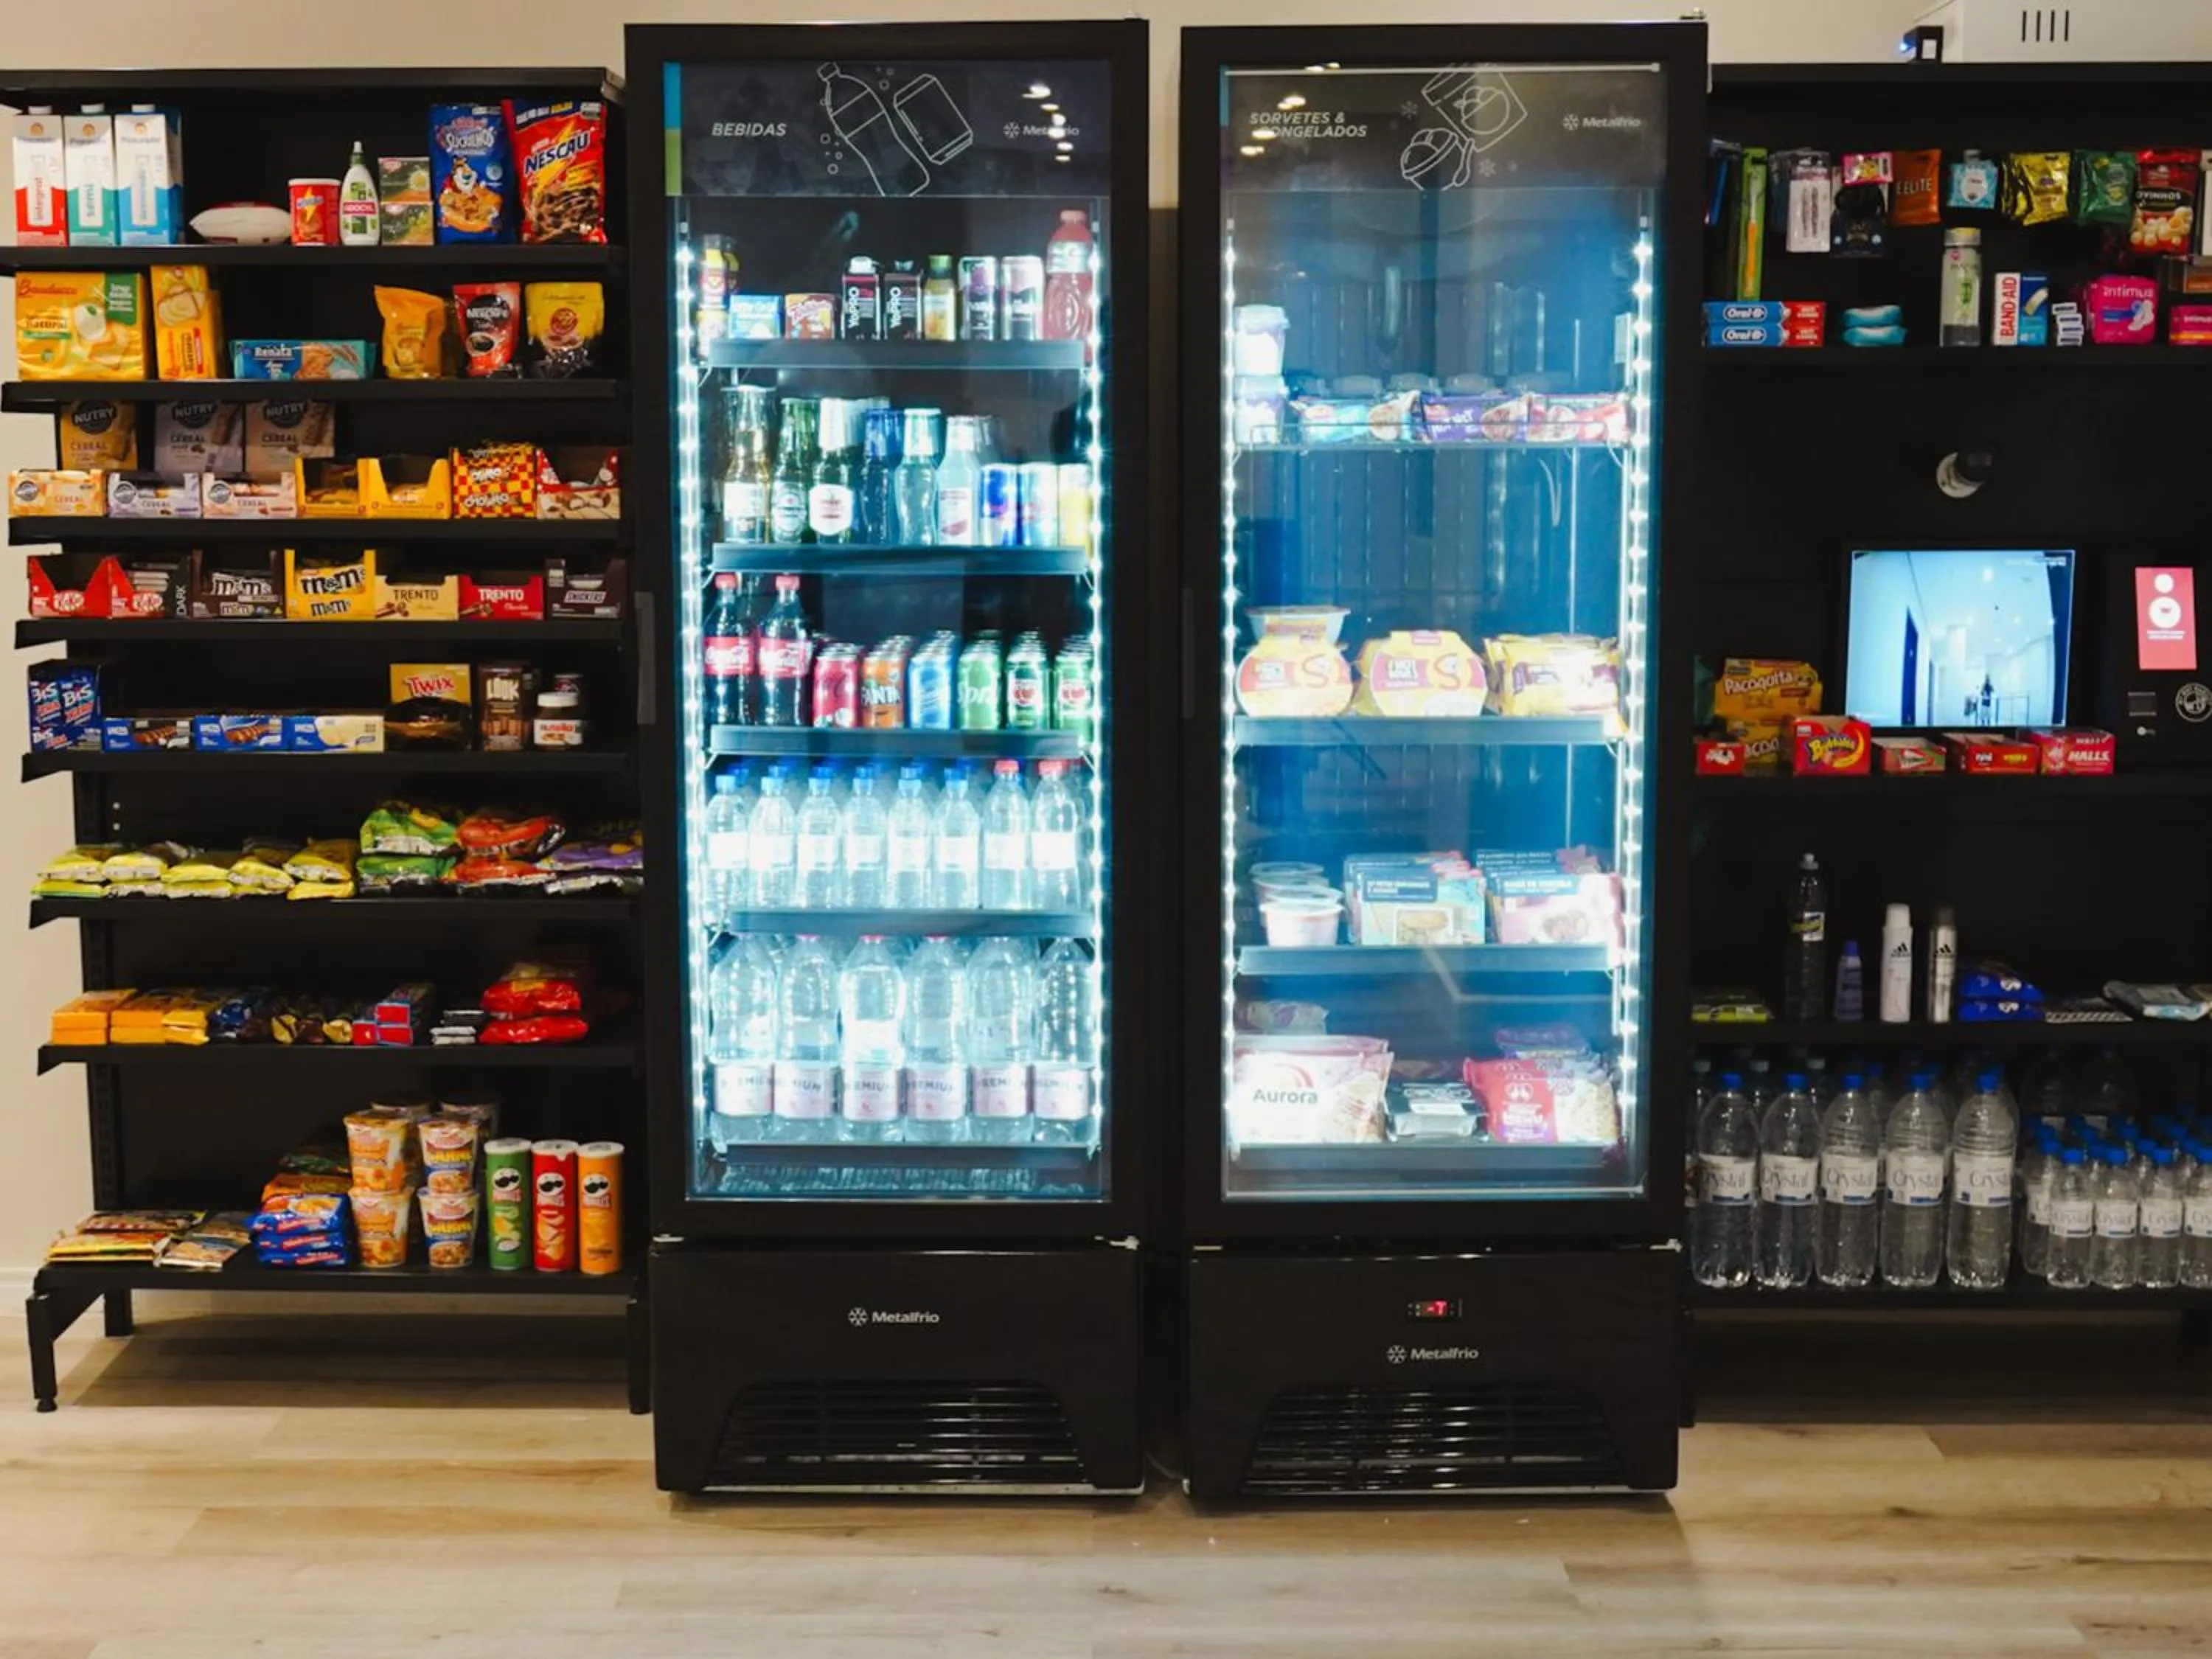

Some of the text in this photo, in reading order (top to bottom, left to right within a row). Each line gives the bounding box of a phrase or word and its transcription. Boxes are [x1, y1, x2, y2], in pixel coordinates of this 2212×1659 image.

[1249, 112, 1345, 125] SORVETES &
[711, 122, 787, 137] BEBIDAS
[1023, 125, 1080, 137] Metrio
[524, 132, 590, 175] NESCAU
[74, 406, 116, 424] NUTRY
[175, 403, 216, 418] NUTRY
[265, 403, 305, 418] NUTRY
[170, 434, 206, 442] CEREAL
[262, 434, 296, 442] CEREAL
[176, 585, 187, 616] DARK
[393, 589, 439, 602] TRENTO
[478, 588, 524, 602] TRENTO
[2067, 750, 2111, 762] HALLS
[1253, 1088, 1319, 1105] Aurora
[872, 1311, 940, 1324] Metalfrio
[1410, 1347, 1479, 1360] Metalfrio
